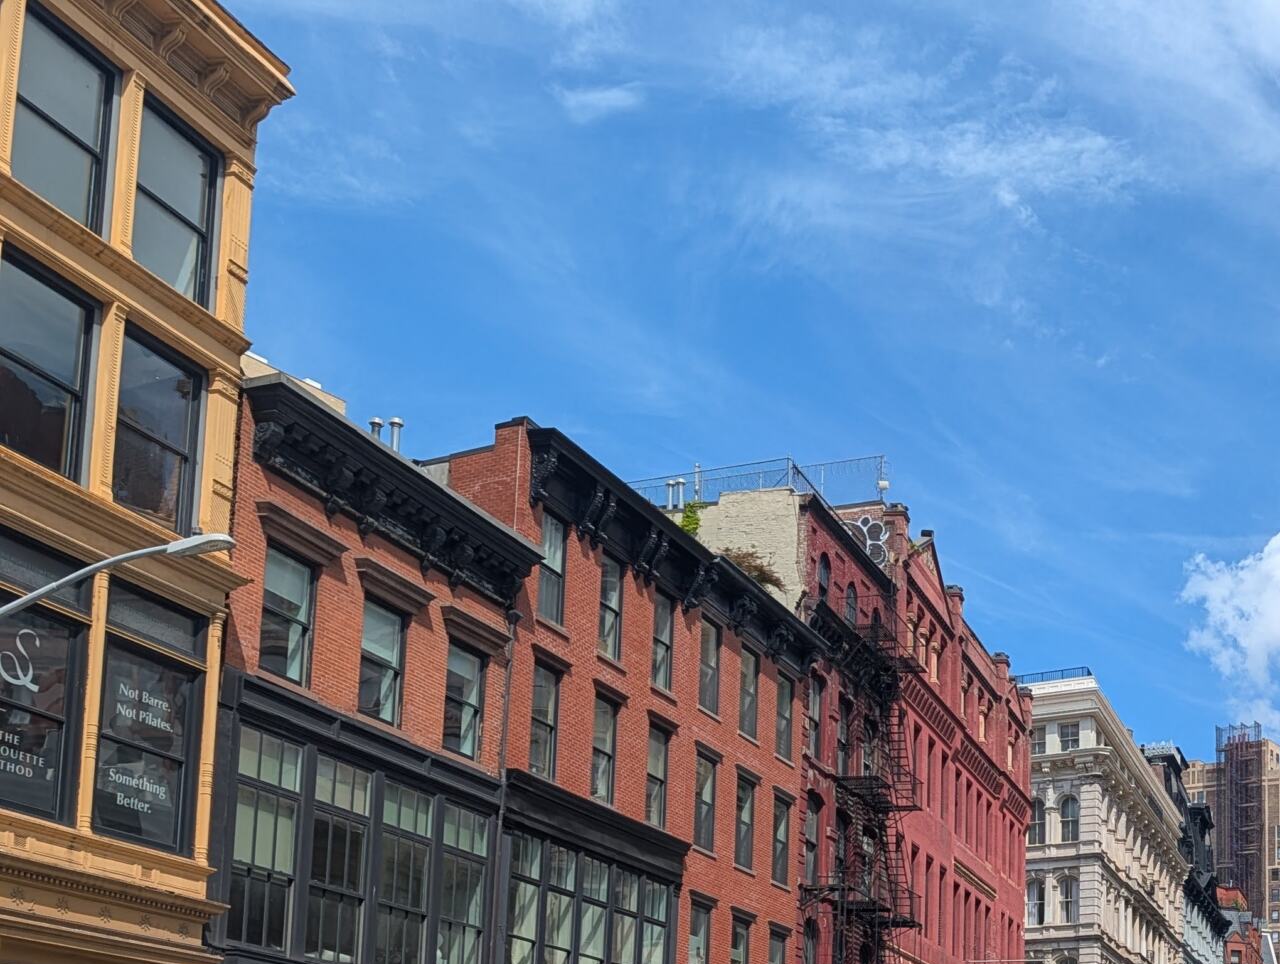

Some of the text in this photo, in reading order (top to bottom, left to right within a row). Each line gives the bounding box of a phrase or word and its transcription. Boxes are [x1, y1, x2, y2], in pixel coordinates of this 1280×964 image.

[119, 683, 172, 712] Not Barre.
[116, 702, 174, 733] Not Pilates.
[109, 768, 167, 799] Something
[116, 793, 152, 813] Better.
